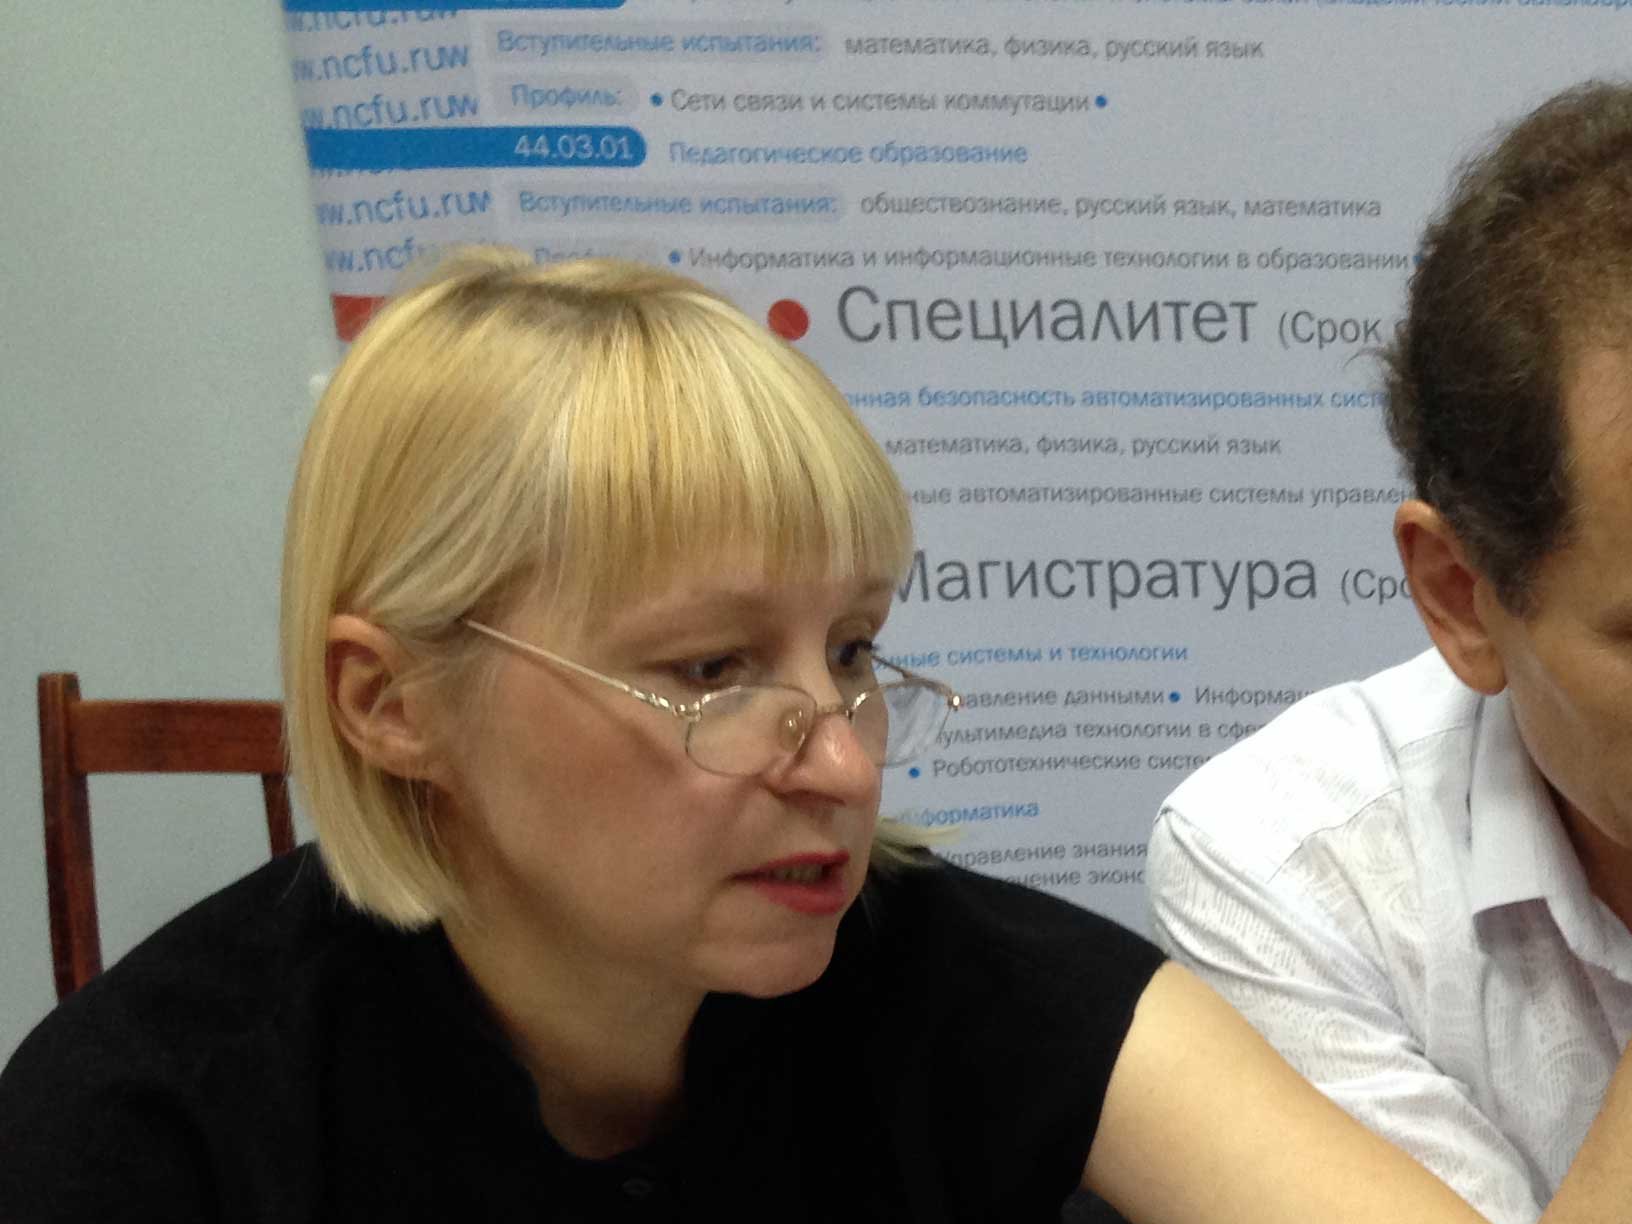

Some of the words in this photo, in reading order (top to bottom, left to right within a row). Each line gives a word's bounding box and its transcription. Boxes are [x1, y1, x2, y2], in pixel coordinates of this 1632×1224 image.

[497, 29, 674, 56] Вступительные
[682, 33, 822, 53] испытания:
[845, 37, 998, 57] математика,
[1005, 35, 1098, 60] физика,
[1105, 34, 1197, 61] русский
[1206, 38, 1264, 57] язык
[511, 83, 622, 110] Профиль:
[671, 88, 726, 112] Сети
[733, 93, 802, 112] связи
[810, 94, 825, 111] и
[833, 93, 935, 112] системы
[944, 93, 1089, 115] коммутации
[514, 134, 633, 159] 44.03.01
[670, 142, 862, 165] Педагогическое
[870, 141, 1027, 166] образование
[520, 190, 692, 217] Вступительные
[702, 194, 838, 214] испытания:
[860, 193, 1069, 218] обществознание,
[1076, 195, 1166, 221] русский
[1174, 197, 1237, 219] язык,
[1244, 199, 1382, 217] математика
[690, 247, 854, 271] Информатика
[861, 251, 876, 267] и
[884, 247, 1097, 269] информационные
[1104, 250, 1230, 268] технологии
[1237, 251, 1249, 269] в
[1257, 246, 1408, 273] образовании
[838, 286, 1259, 349] Специалитет
[1279, 310, 1382, 349] (Срок
[918, 387, 1075, 407] безопасность
[1082, 390, 1323, 409] автоматизированных
[1330, 390, 1388, 408] сист
[886, 437, 1029, 456] математика,
[1036, 434, 1124, 457] физика,
[1132, 434, 1220, 458] русский
[1227, 438, 1281, 455] язык
[959, 486, 1202, 506] автоматизированные
[1209, 487, 1304, 504] системы
[947, 647, 1041, 666] системы
[1050, 648, 1062, 662] и
[1069, 646, 1188, 663] технологии
[1064, 688, 1164, 706] данными
[1075, 721, 1191, 738] технологии
[1198, 723, 1211, 738] в
[932, 754, 1140, 778] Робототехнические
